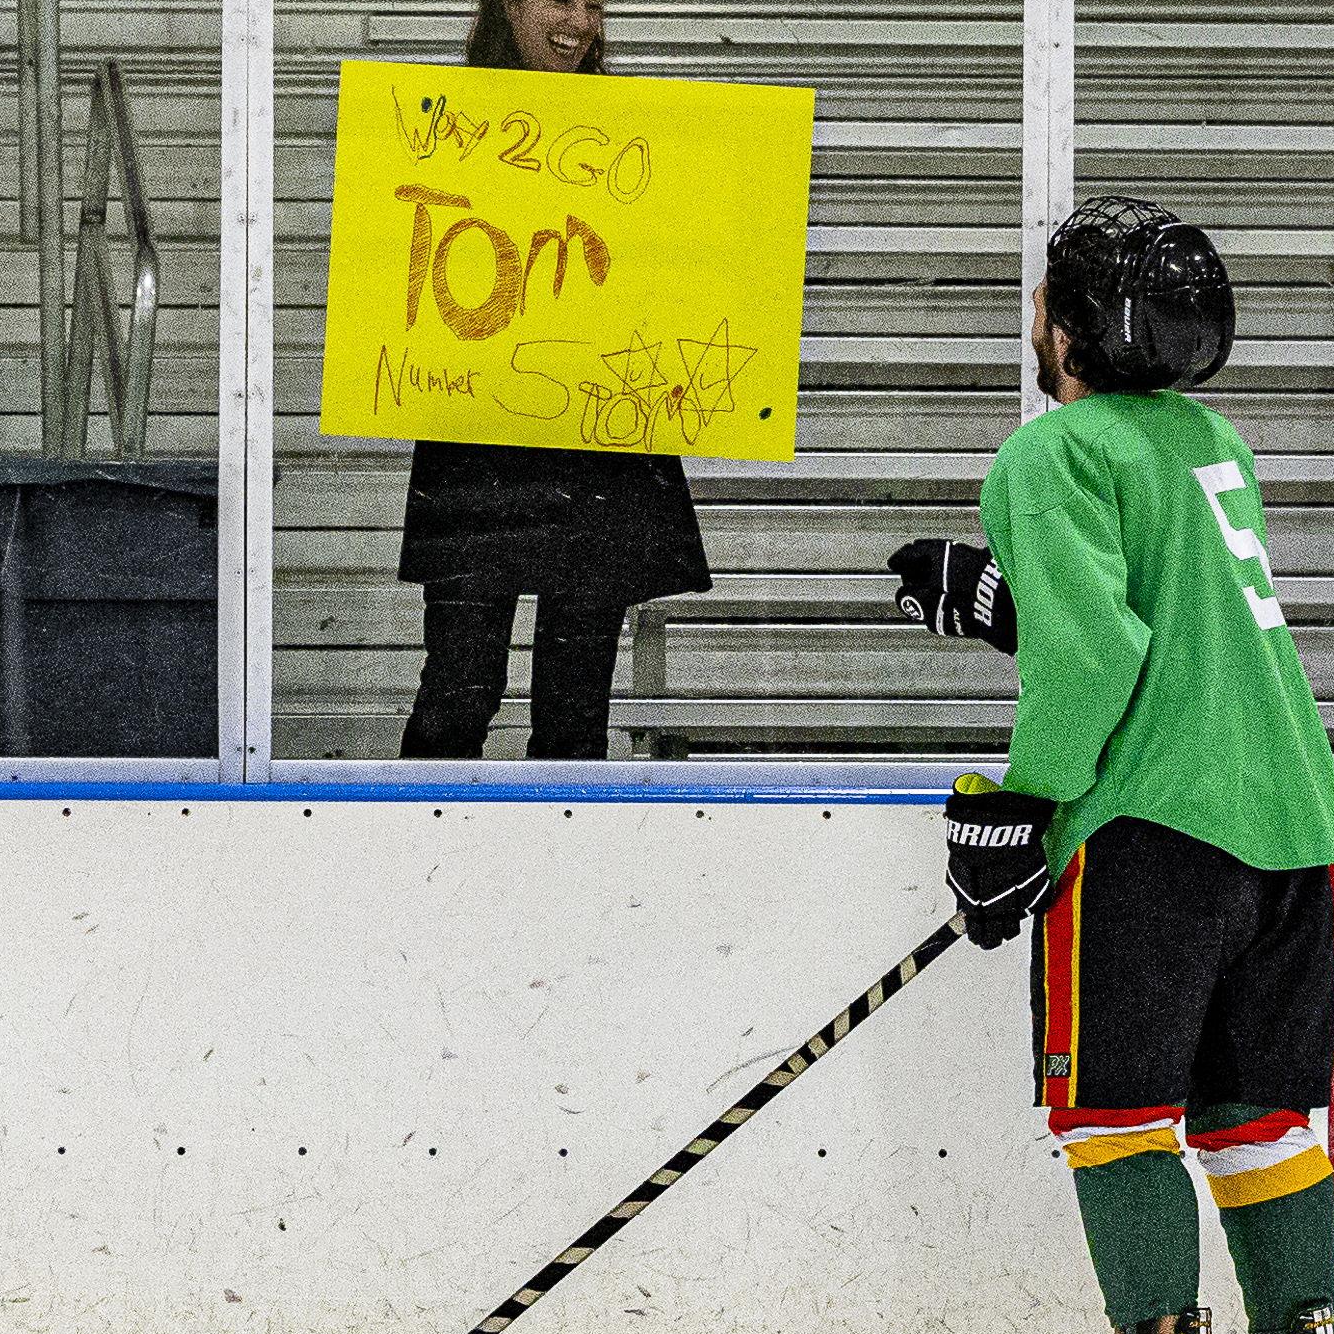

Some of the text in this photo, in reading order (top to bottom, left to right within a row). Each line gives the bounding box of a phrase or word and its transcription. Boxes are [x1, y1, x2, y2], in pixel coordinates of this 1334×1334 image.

[497, 110, 542, 173] 2
[489, 339, 593, 421] 5
[1192, 459, 1288, 631] 5
